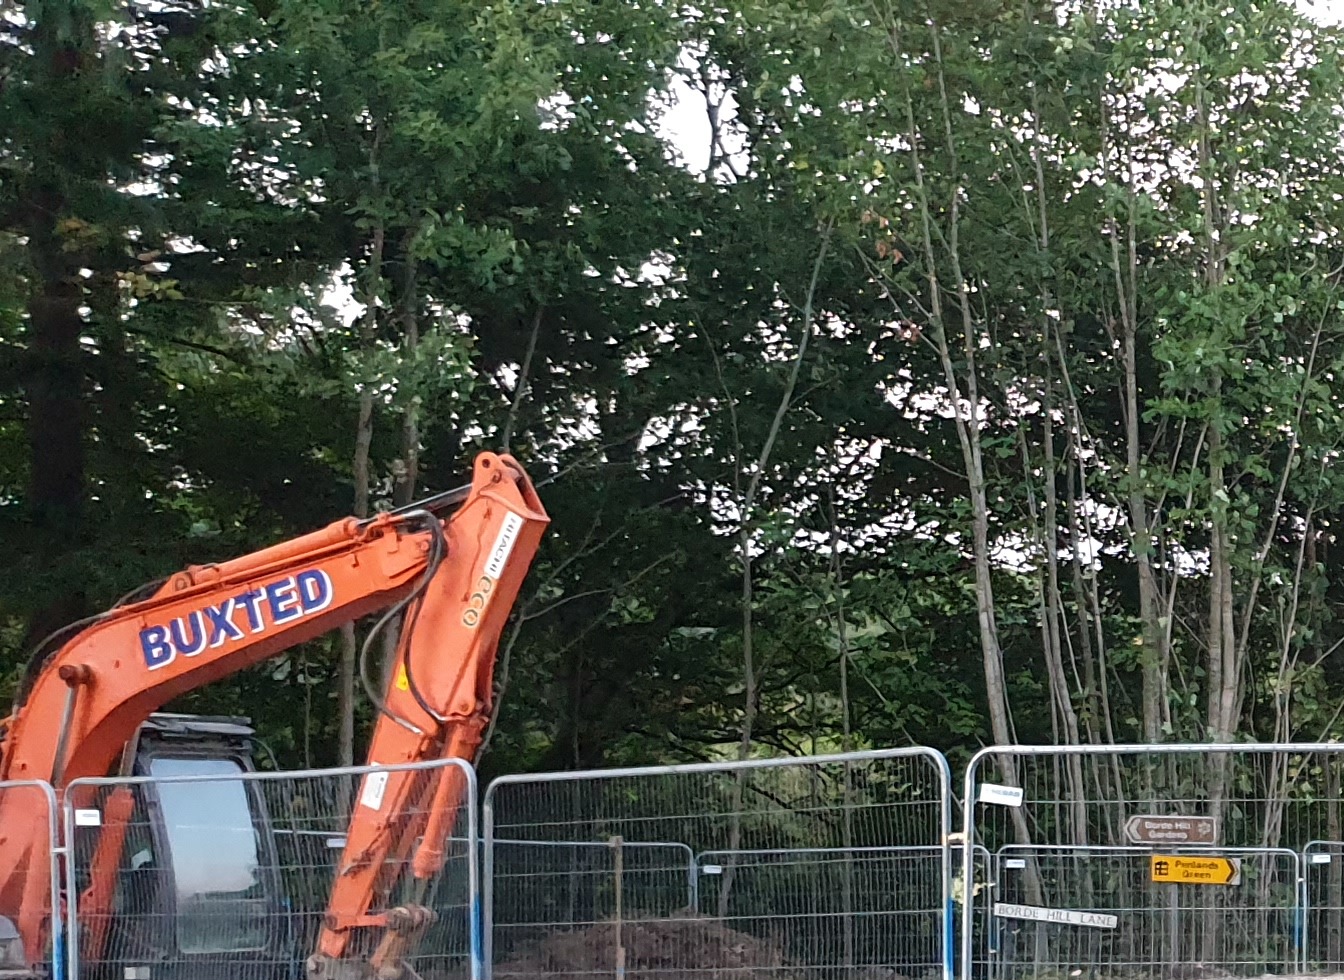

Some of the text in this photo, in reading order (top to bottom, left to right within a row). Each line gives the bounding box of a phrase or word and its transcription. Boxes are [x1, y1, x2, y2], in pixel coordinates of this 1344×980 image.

[489, 517, 517, 573] HITACHI
[139, 569, 333, 671] BUXTED
[1144, 821, 1191, 830] Borde Hill
[998, 904, 1114, 926] BORDE HILL LANE
